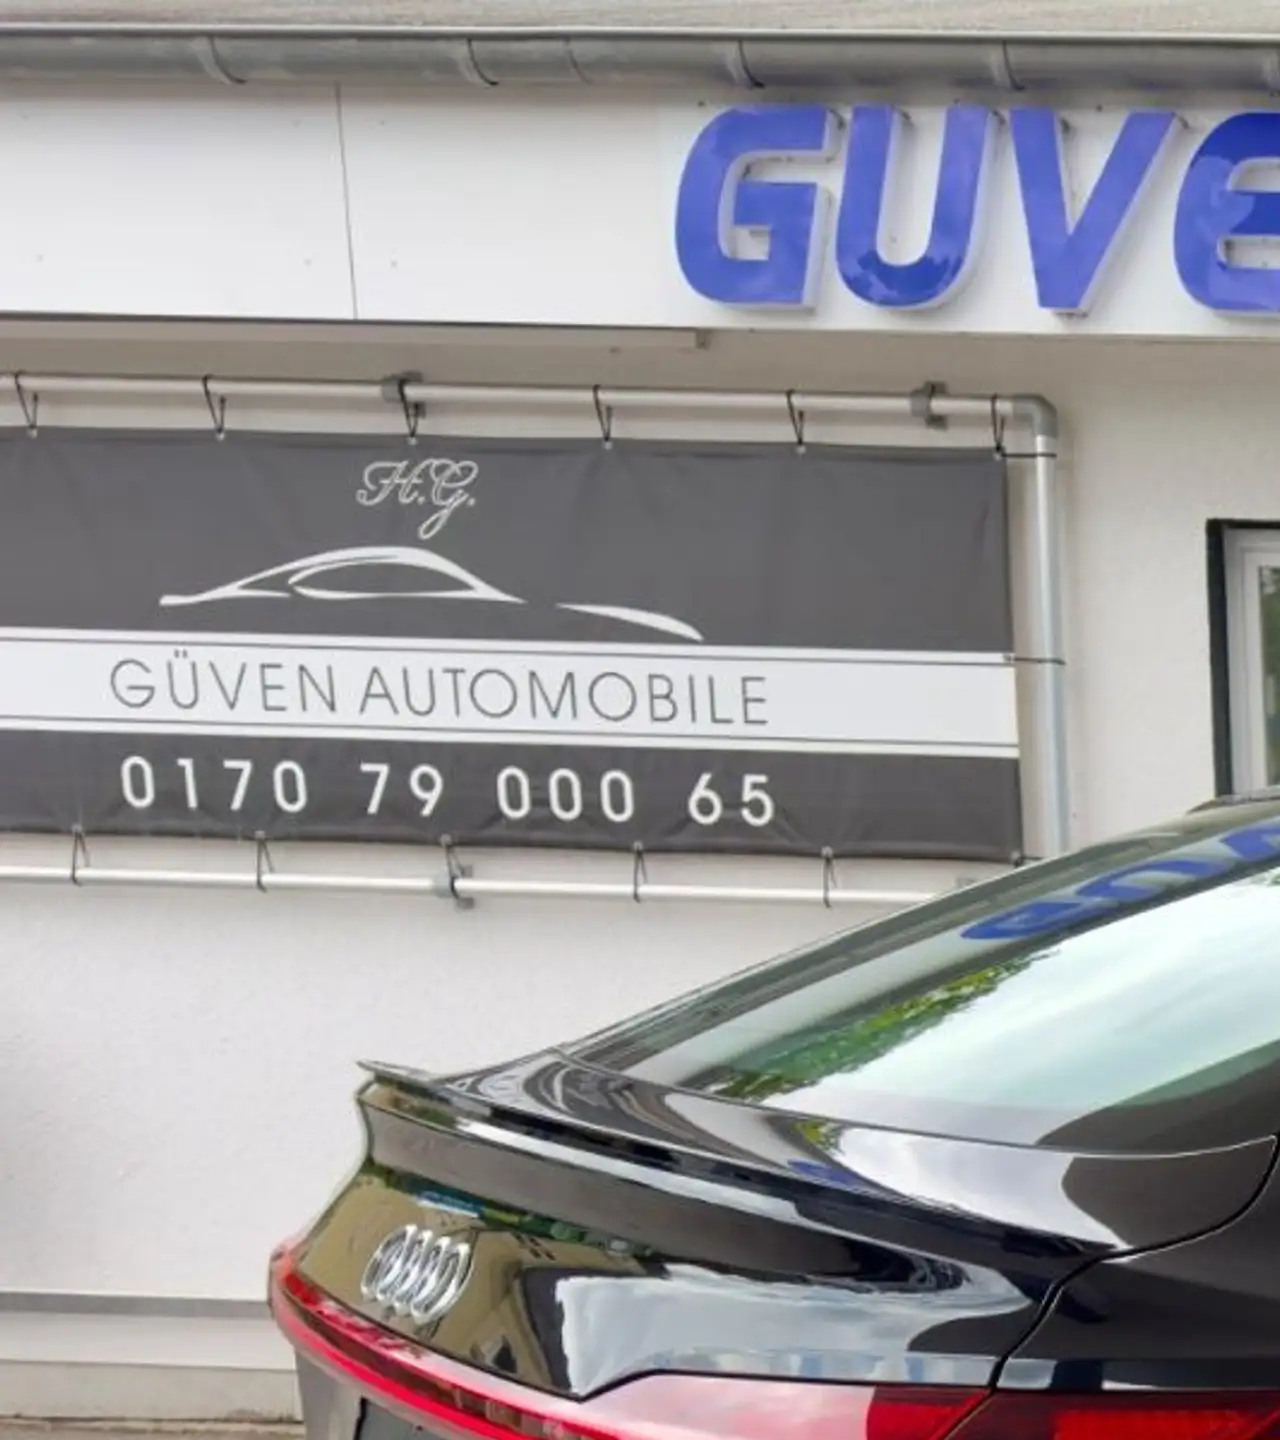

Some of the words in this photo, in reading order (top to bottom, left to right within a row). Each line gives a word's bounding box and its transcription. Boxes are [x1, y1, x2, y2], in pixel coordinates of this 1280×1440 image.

[109, 649, 338, 713] GÜVEN
[358, 664, 769, 727] AUTOMOBILE
[119, 755, 309, 814] 0170
[360, 762, 444, 818] 79
[496, 766, 636, 823] 000
[687, 770, 777, 827] 65
